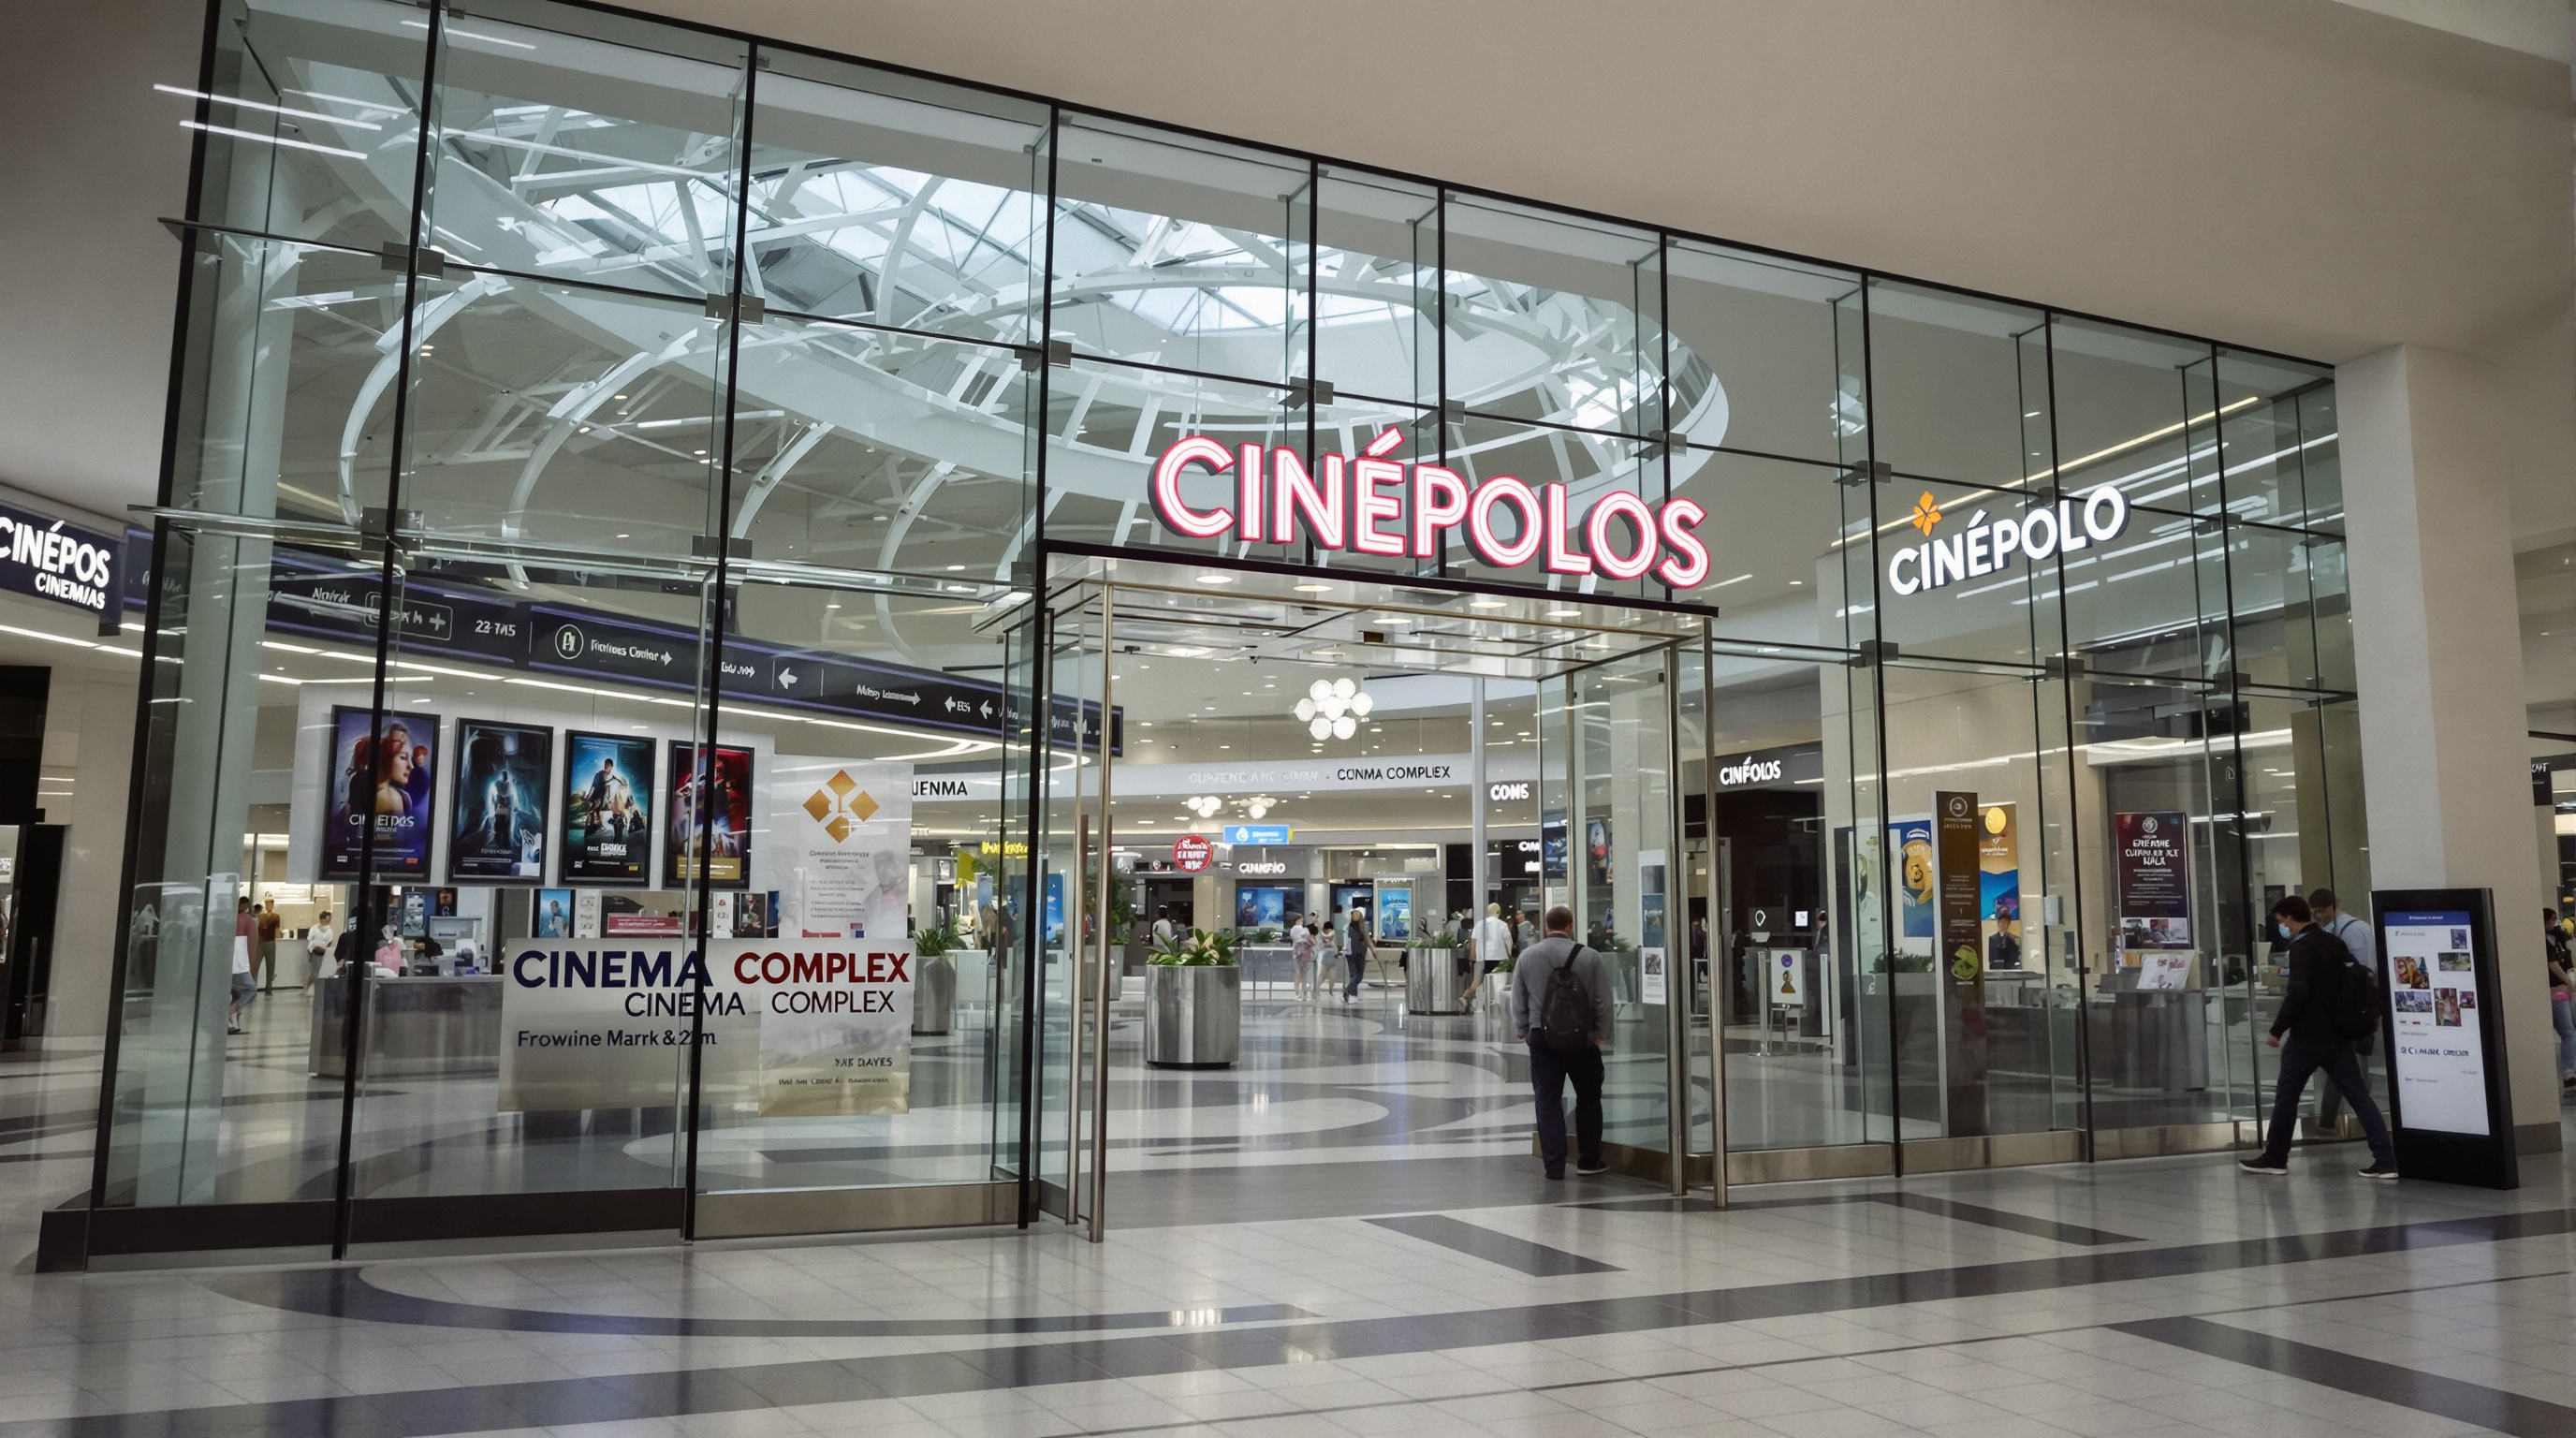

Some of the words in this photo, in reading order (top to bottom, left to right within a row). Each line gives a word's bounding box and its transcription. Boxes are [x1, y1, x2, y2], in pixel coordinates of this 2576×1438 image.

[1149, 425, 1711, 589] CINÉPOLOS
[0, 517, 110, 588] CINÉPOS
[1889, 485, 2130, 595] CINÉPOLO
[513, 950, 714, 988] CINEMA
[734, 952, 910, 984] COMPLEX
[624, 991, 746, 1017] CINEMA
[771, 990, 895, 1014] COMPLEX
[663, 1030, 676, 1046] &
